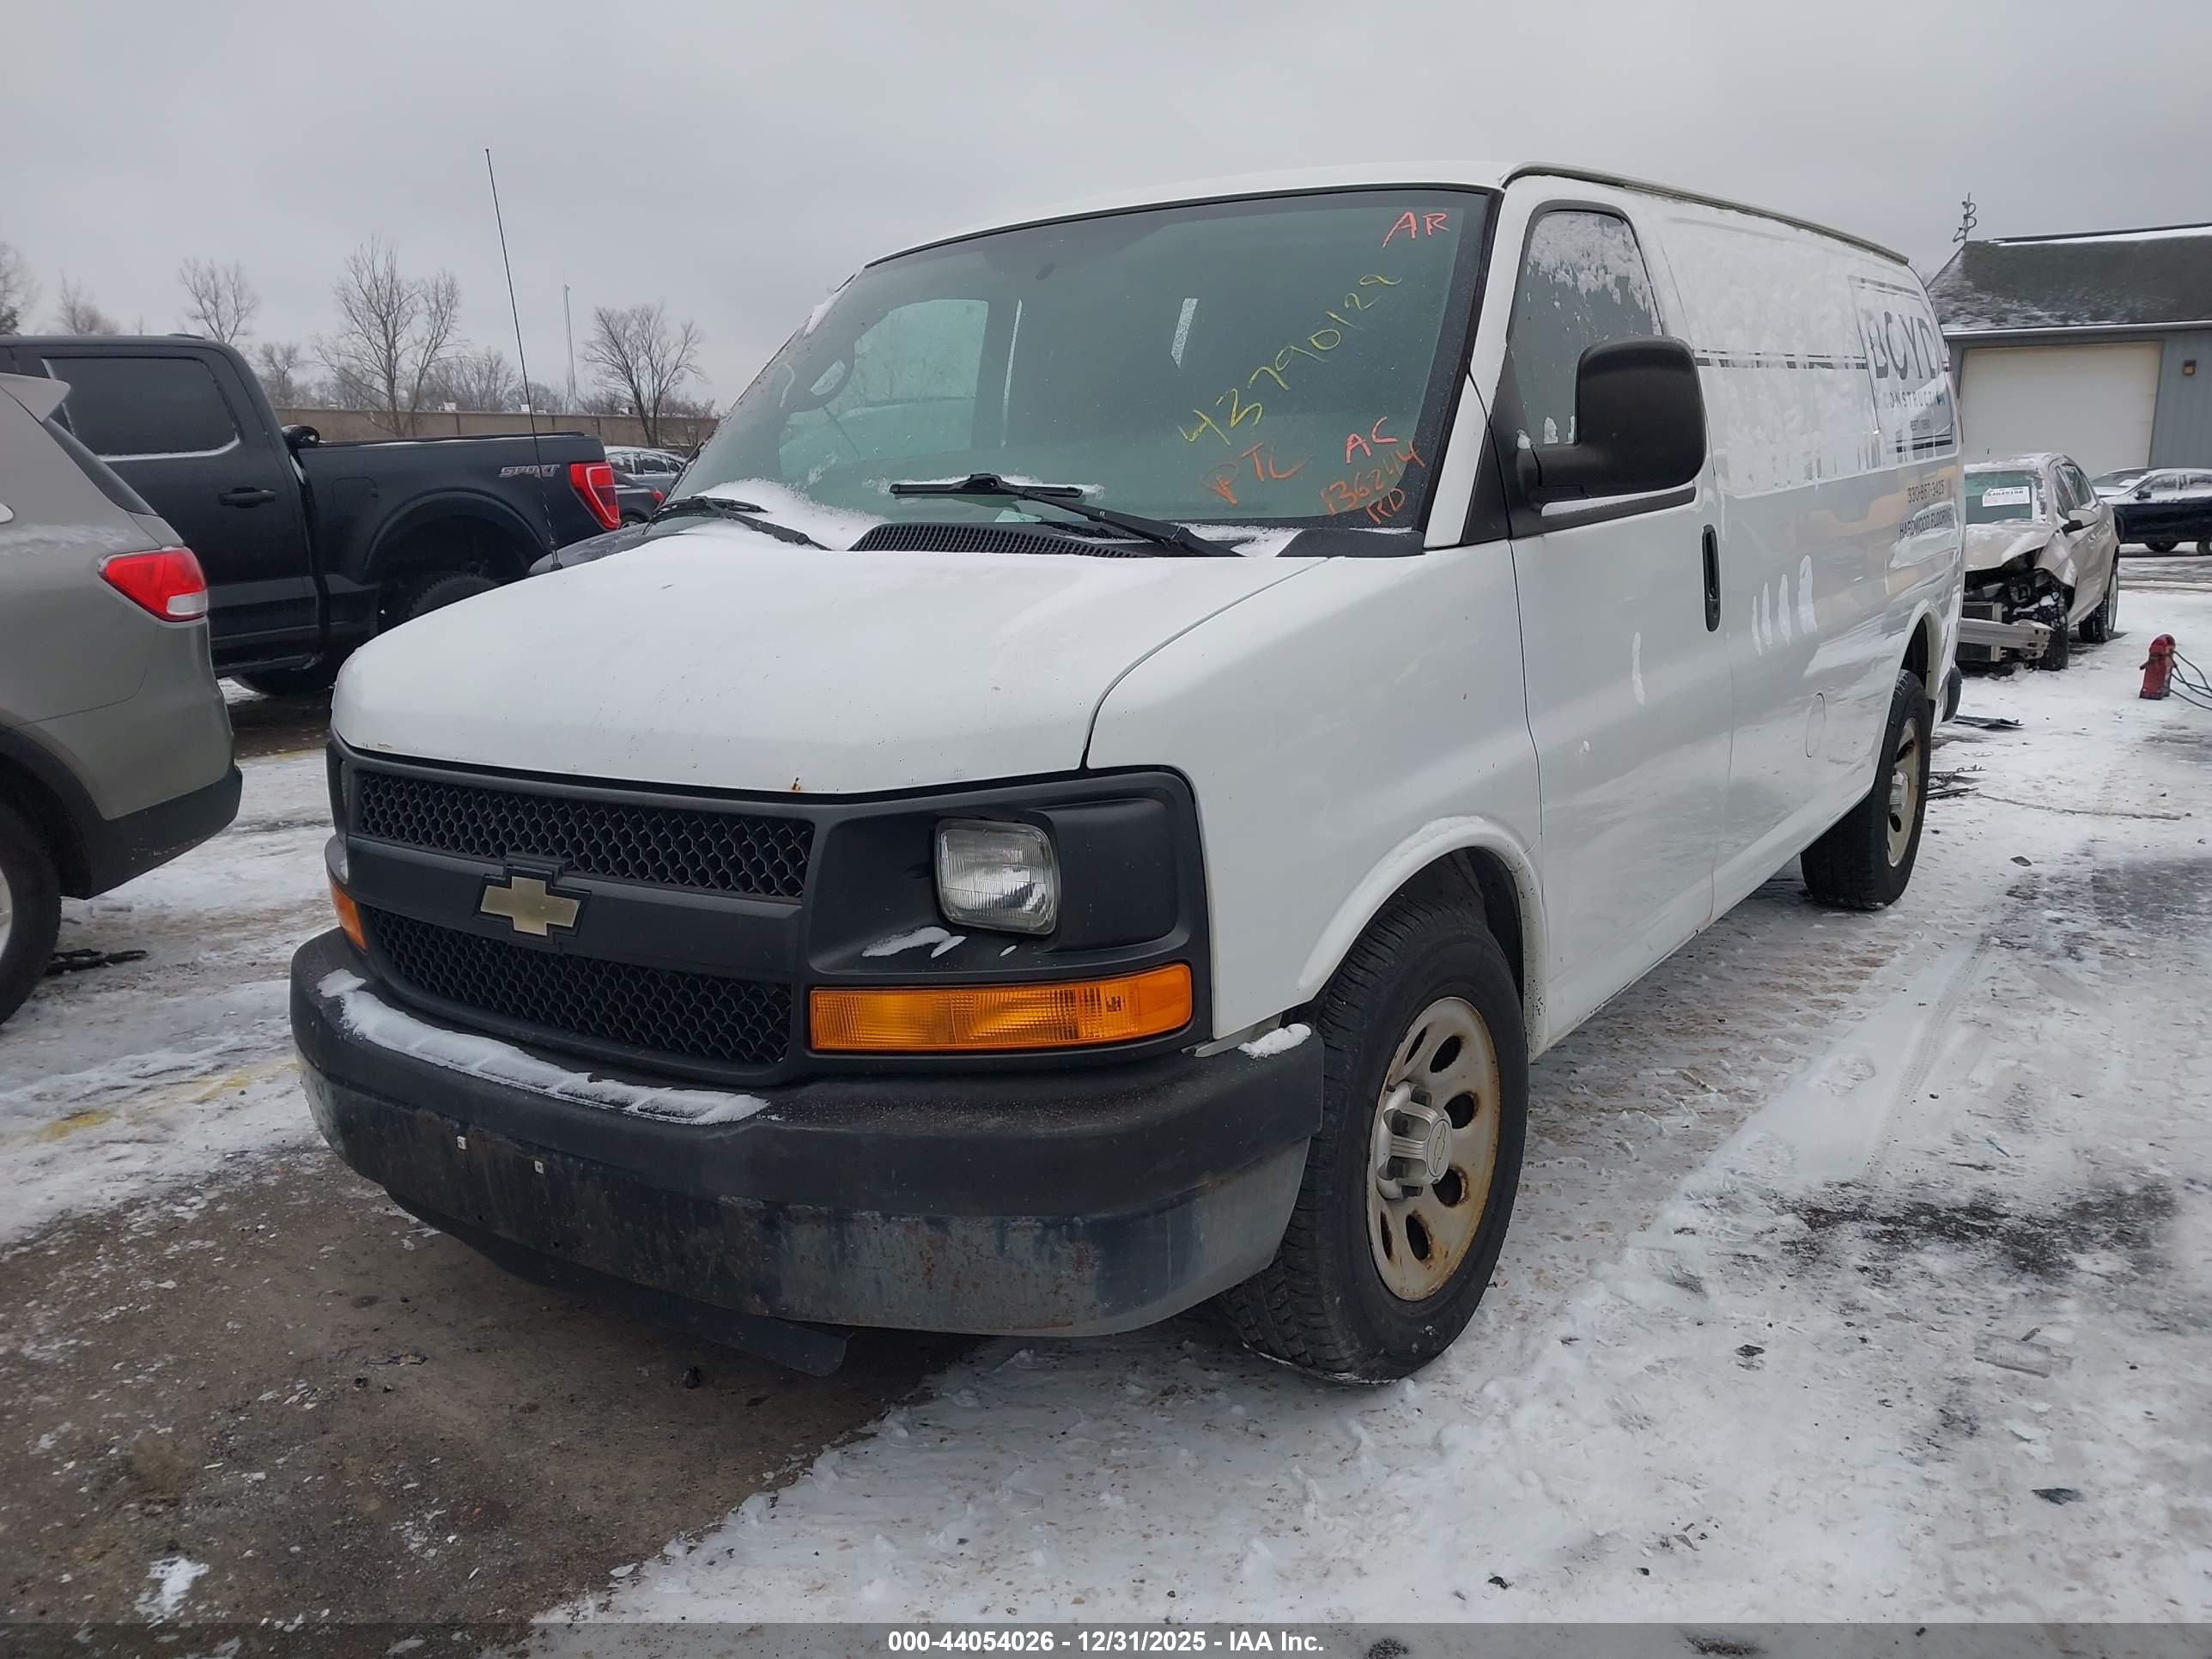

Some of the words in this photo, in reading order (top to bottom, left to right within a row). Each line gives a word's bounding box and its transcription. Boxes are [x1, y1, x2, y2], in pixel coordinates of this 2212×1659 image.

[1382, 210, 1450, 249] AR
[1345, 416, 1399, 465] AC
[498, 463, 562, 479] SPORT
[1899, 514, 1930, 541] HARDWOOD
